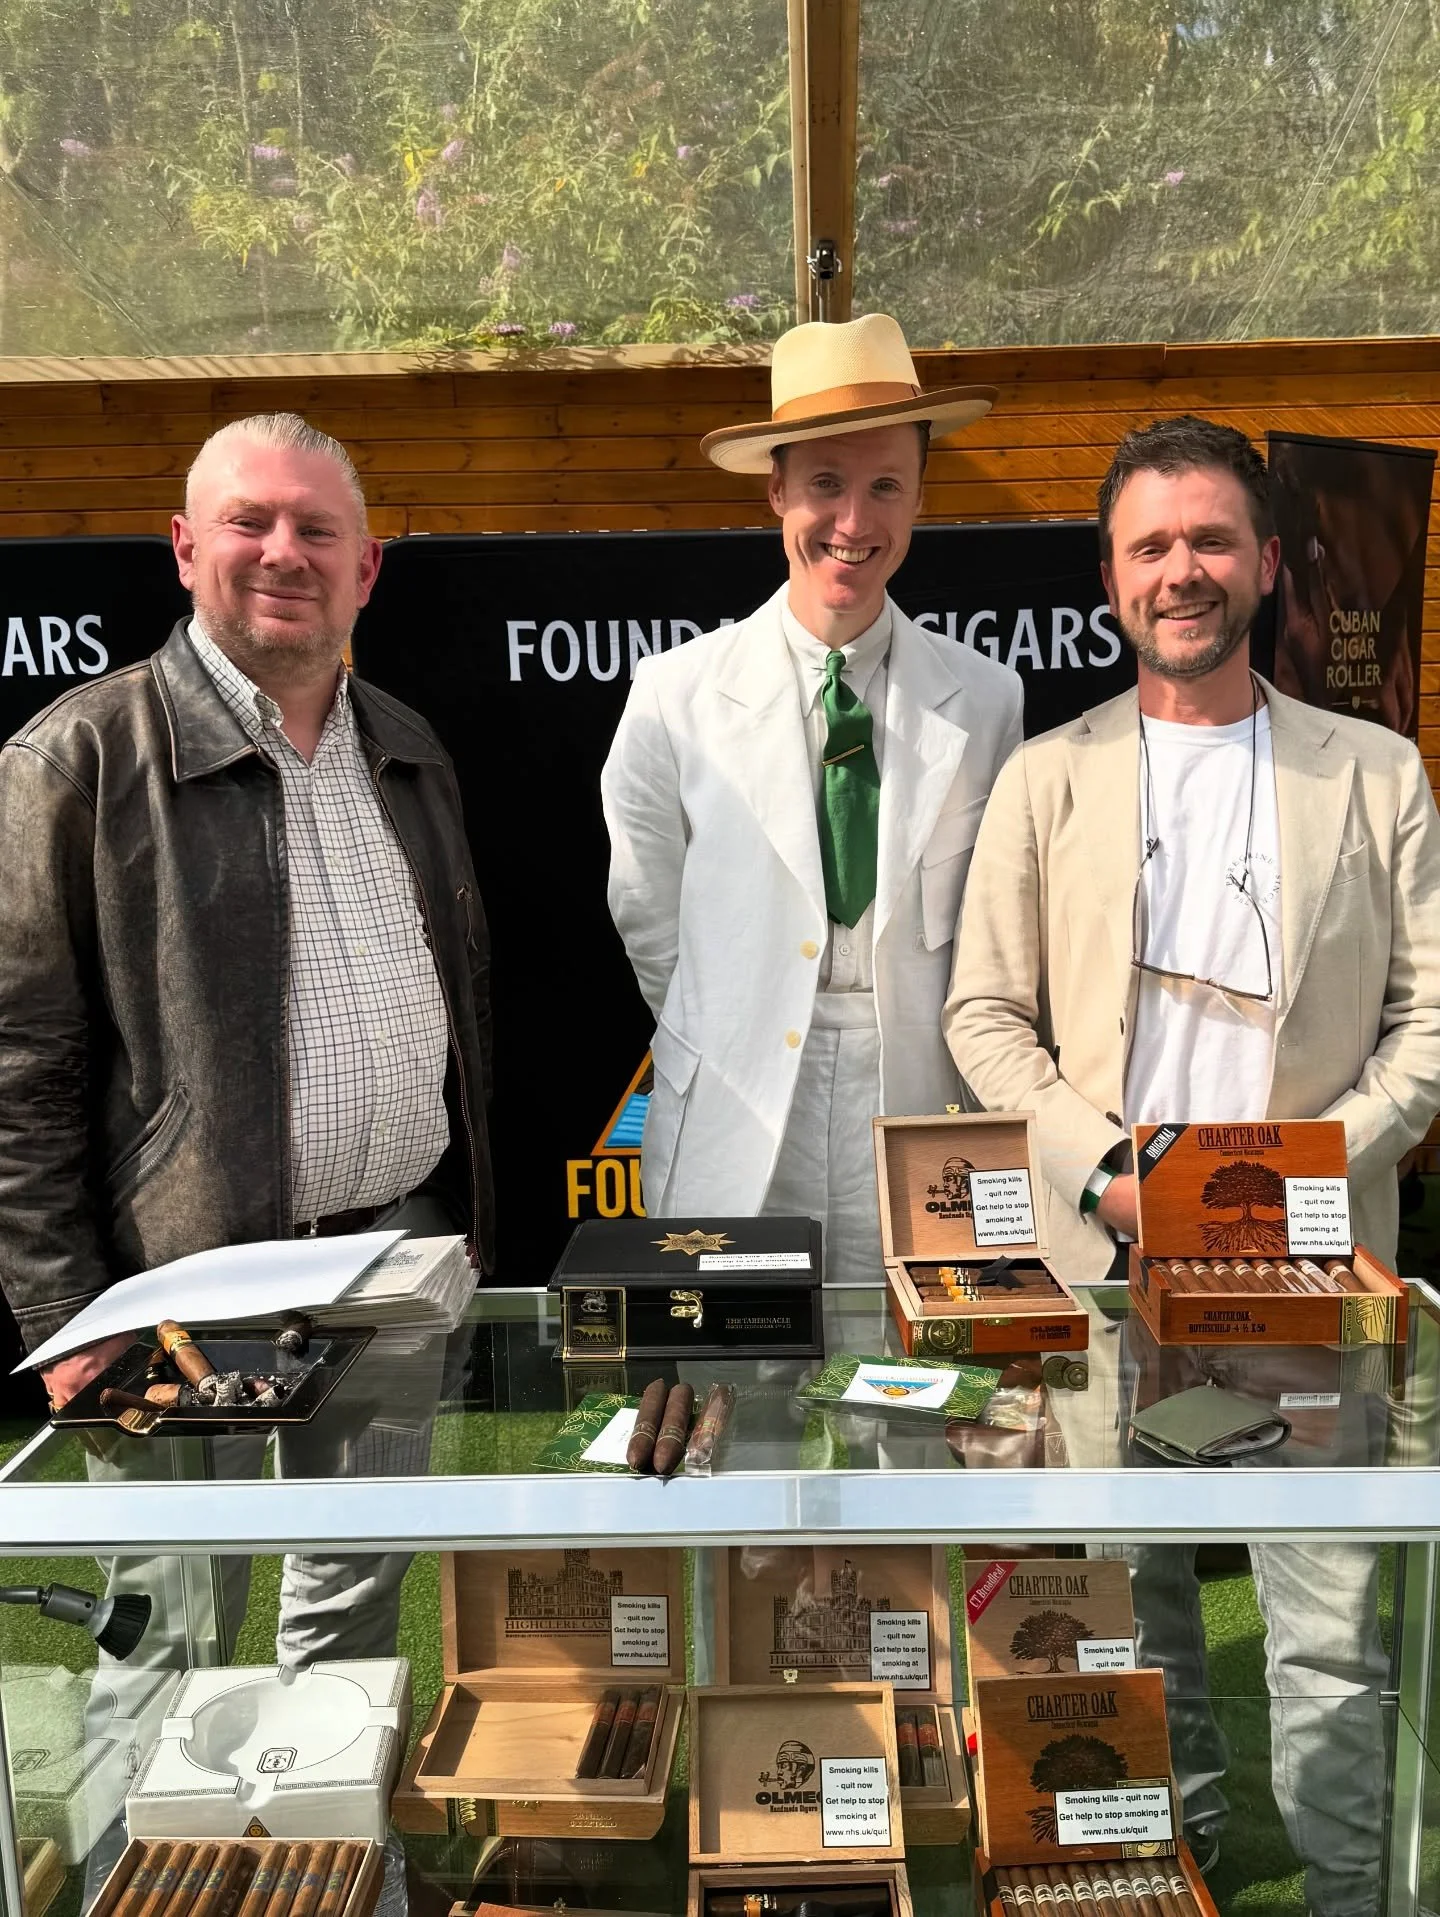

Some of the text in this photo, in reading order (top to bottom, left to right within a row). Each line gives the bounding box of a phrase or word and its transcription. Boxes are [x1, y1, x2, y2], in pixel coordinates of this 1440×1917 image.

[1329, 610, 1380, 633] CUBAN
[506, 618, 735, 681] FOUN
[1331, 638, 1377, 660] CIGAR
[1326, 664, 1382, 688] ROLLER
[1198, 1125, 1283, 1147] CHARTER OAK
[1145, 1127, 1174, 1158] ORIGINAL
[977, 1177, 1007, 1185] Smoking
[1292, 1184, 1324, 1192] Smoking
[989, 1190, 1002, 1198] quit
[926, 1200, 972, 1213] OLM
[985, 1216, 1014, 1224] smoking
[978, 1228, 1033, 1237] www.nhs.uk/quit
[969, 1563, 1005, 1608] CT Broadleaf
[1009, 1575, 1089, 1595] CHARTER OAK
[505, 1620, 580, 1629] HIGHCLERE
[877, 1618, 906, 1626] Smoking
[1083, 1646, 1114, 1654] Smoking
[613, 1651, 667, 1659] www.nhs.uk/quit
[770, 1654, 845, 1664] HIGHCLERE
[1095, 1661, 1109, 1669] quit
[873, 1673, 928, 1681] www.nhs.uk/quit
[1027, 1691, 1118, 1718] CHARTER OAK
[828, 1766, 862, 1775] Smoking
[840, 1782, 856, 1790] quit
[840, 1797, 857, 1805] help
[868, 1797, 885, 1805] stop
[1065, 1795, 1100, 1804] Smoking
[1102, 1794, 1119, 1802] kills
[1126, 1793, 1141, 1803] quit
[1143, 1793, 1160, 1801] now
[835, 1812, 868, 1821] smoking
[1059, 1813, 1073, 1821] Get
[1075, 1812, 1093, 1821] help
[1104, 1811, 1123, 1819] stop
[1124, 1809, 1159, 1818] smoking
[825, 1828, 888, 1836] www.nhs.uk/quit
[1081, 1825, 1148, 1836] www.nhs.uk/quit
